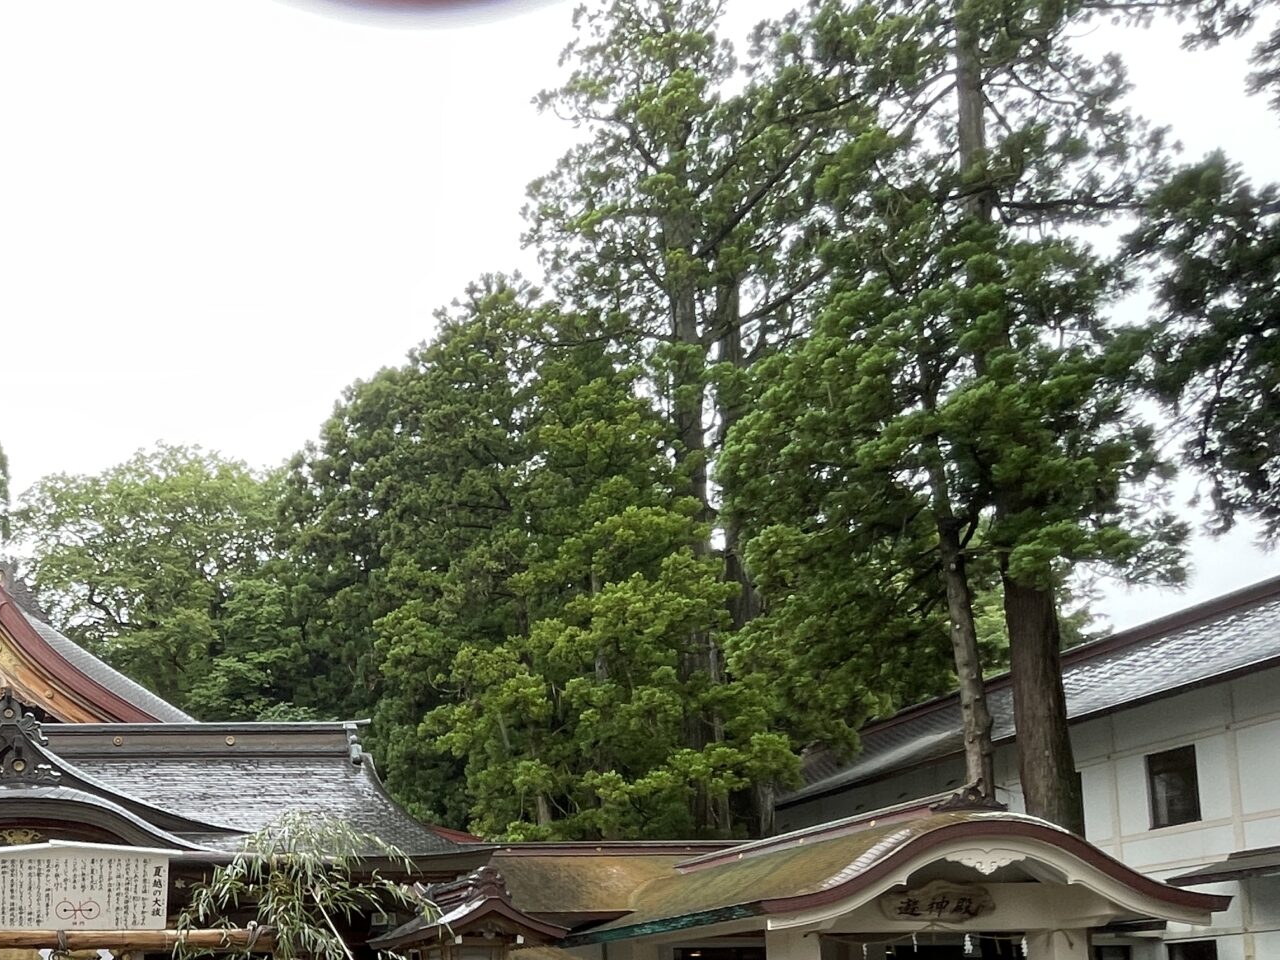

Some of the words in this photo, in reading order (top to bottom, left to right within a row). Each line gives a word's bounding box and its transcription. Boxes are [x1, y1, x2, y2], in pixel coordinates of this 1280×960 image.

[151, 865, 163, 917] 夏越の大祓
[897, 896, 978, 918] 遊神殿
